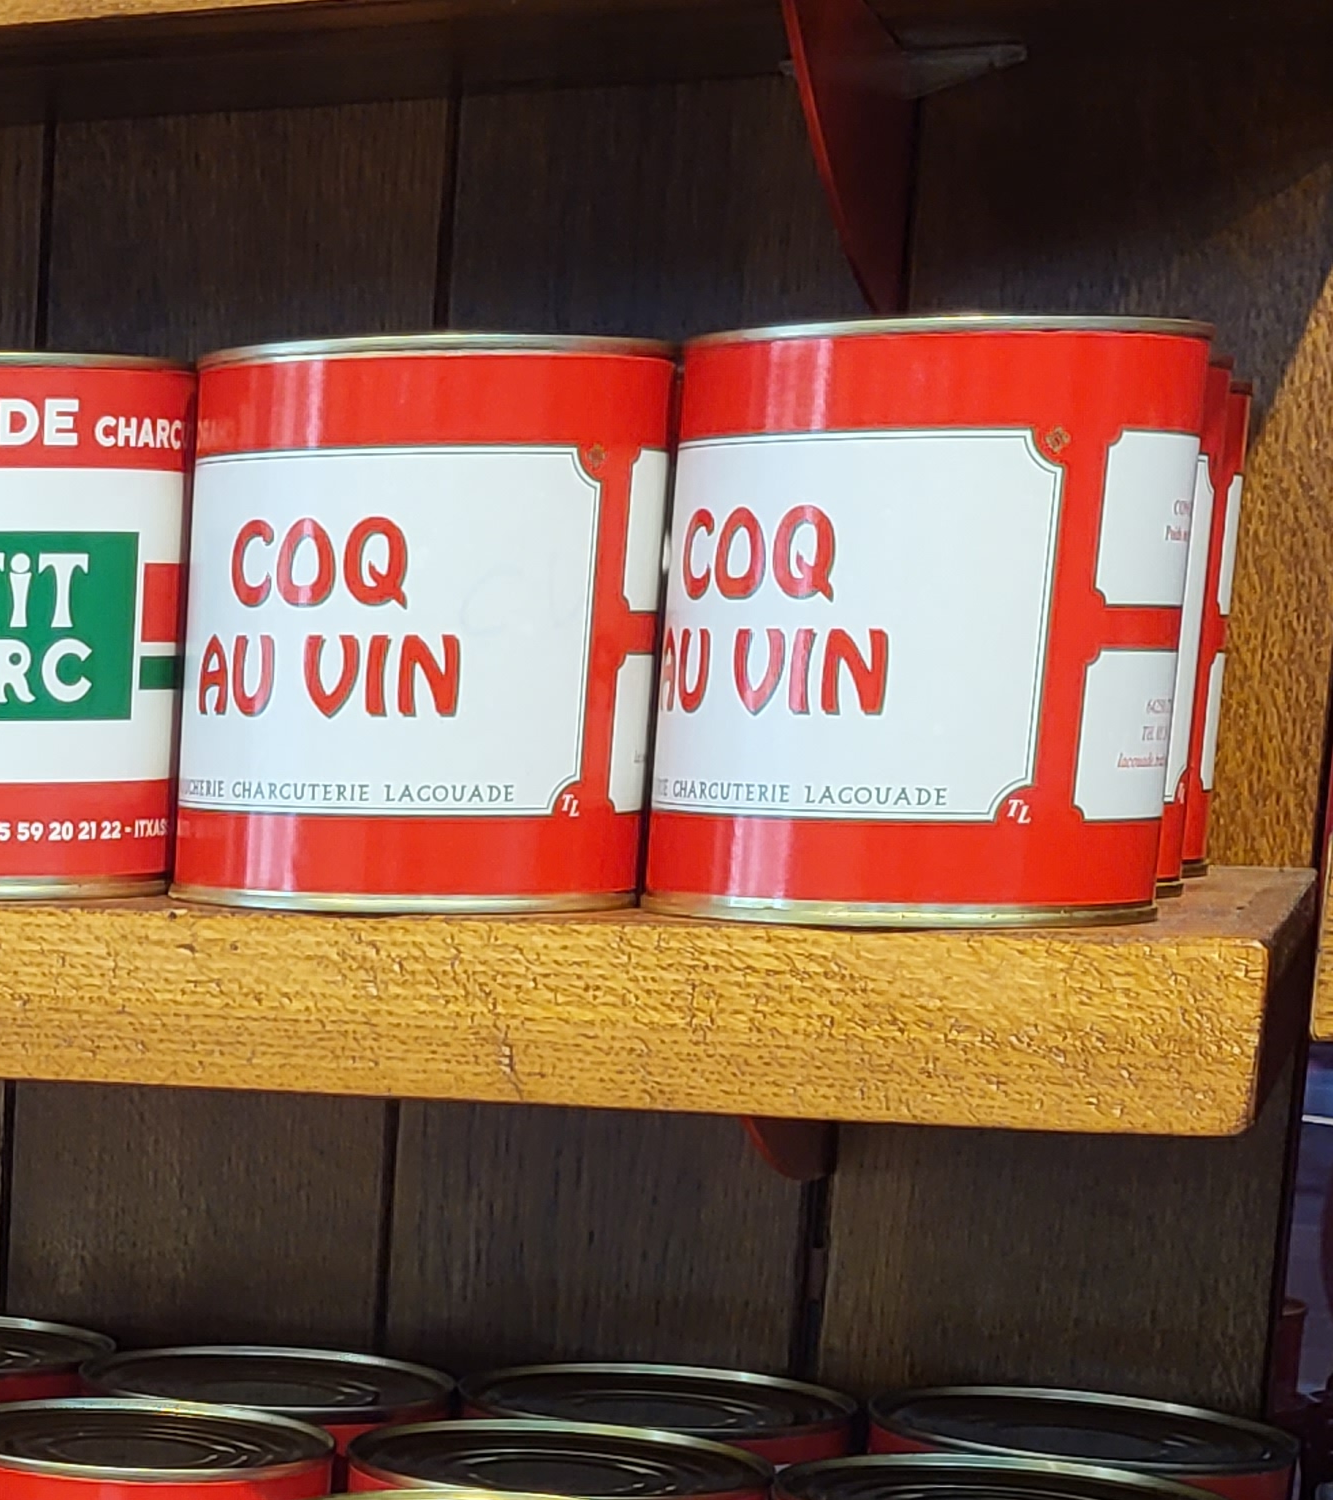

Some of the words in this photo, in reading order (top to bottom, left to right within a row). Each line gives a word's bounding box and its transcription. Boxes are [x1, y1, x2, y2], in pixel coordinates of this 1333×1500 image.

[231, 515, 408, 609] COQ
[682, 505, 835, 603] COQ
[198, 633, 275, 716] AU
[303, 633, 461, 717] VIN
[660, 628, 711, 713] AU
[733, 628, 889, 716] VIN
[231, 779, 370, 803] CHARCUTERIE
[384, 783, 516, 804] LACOUADE
